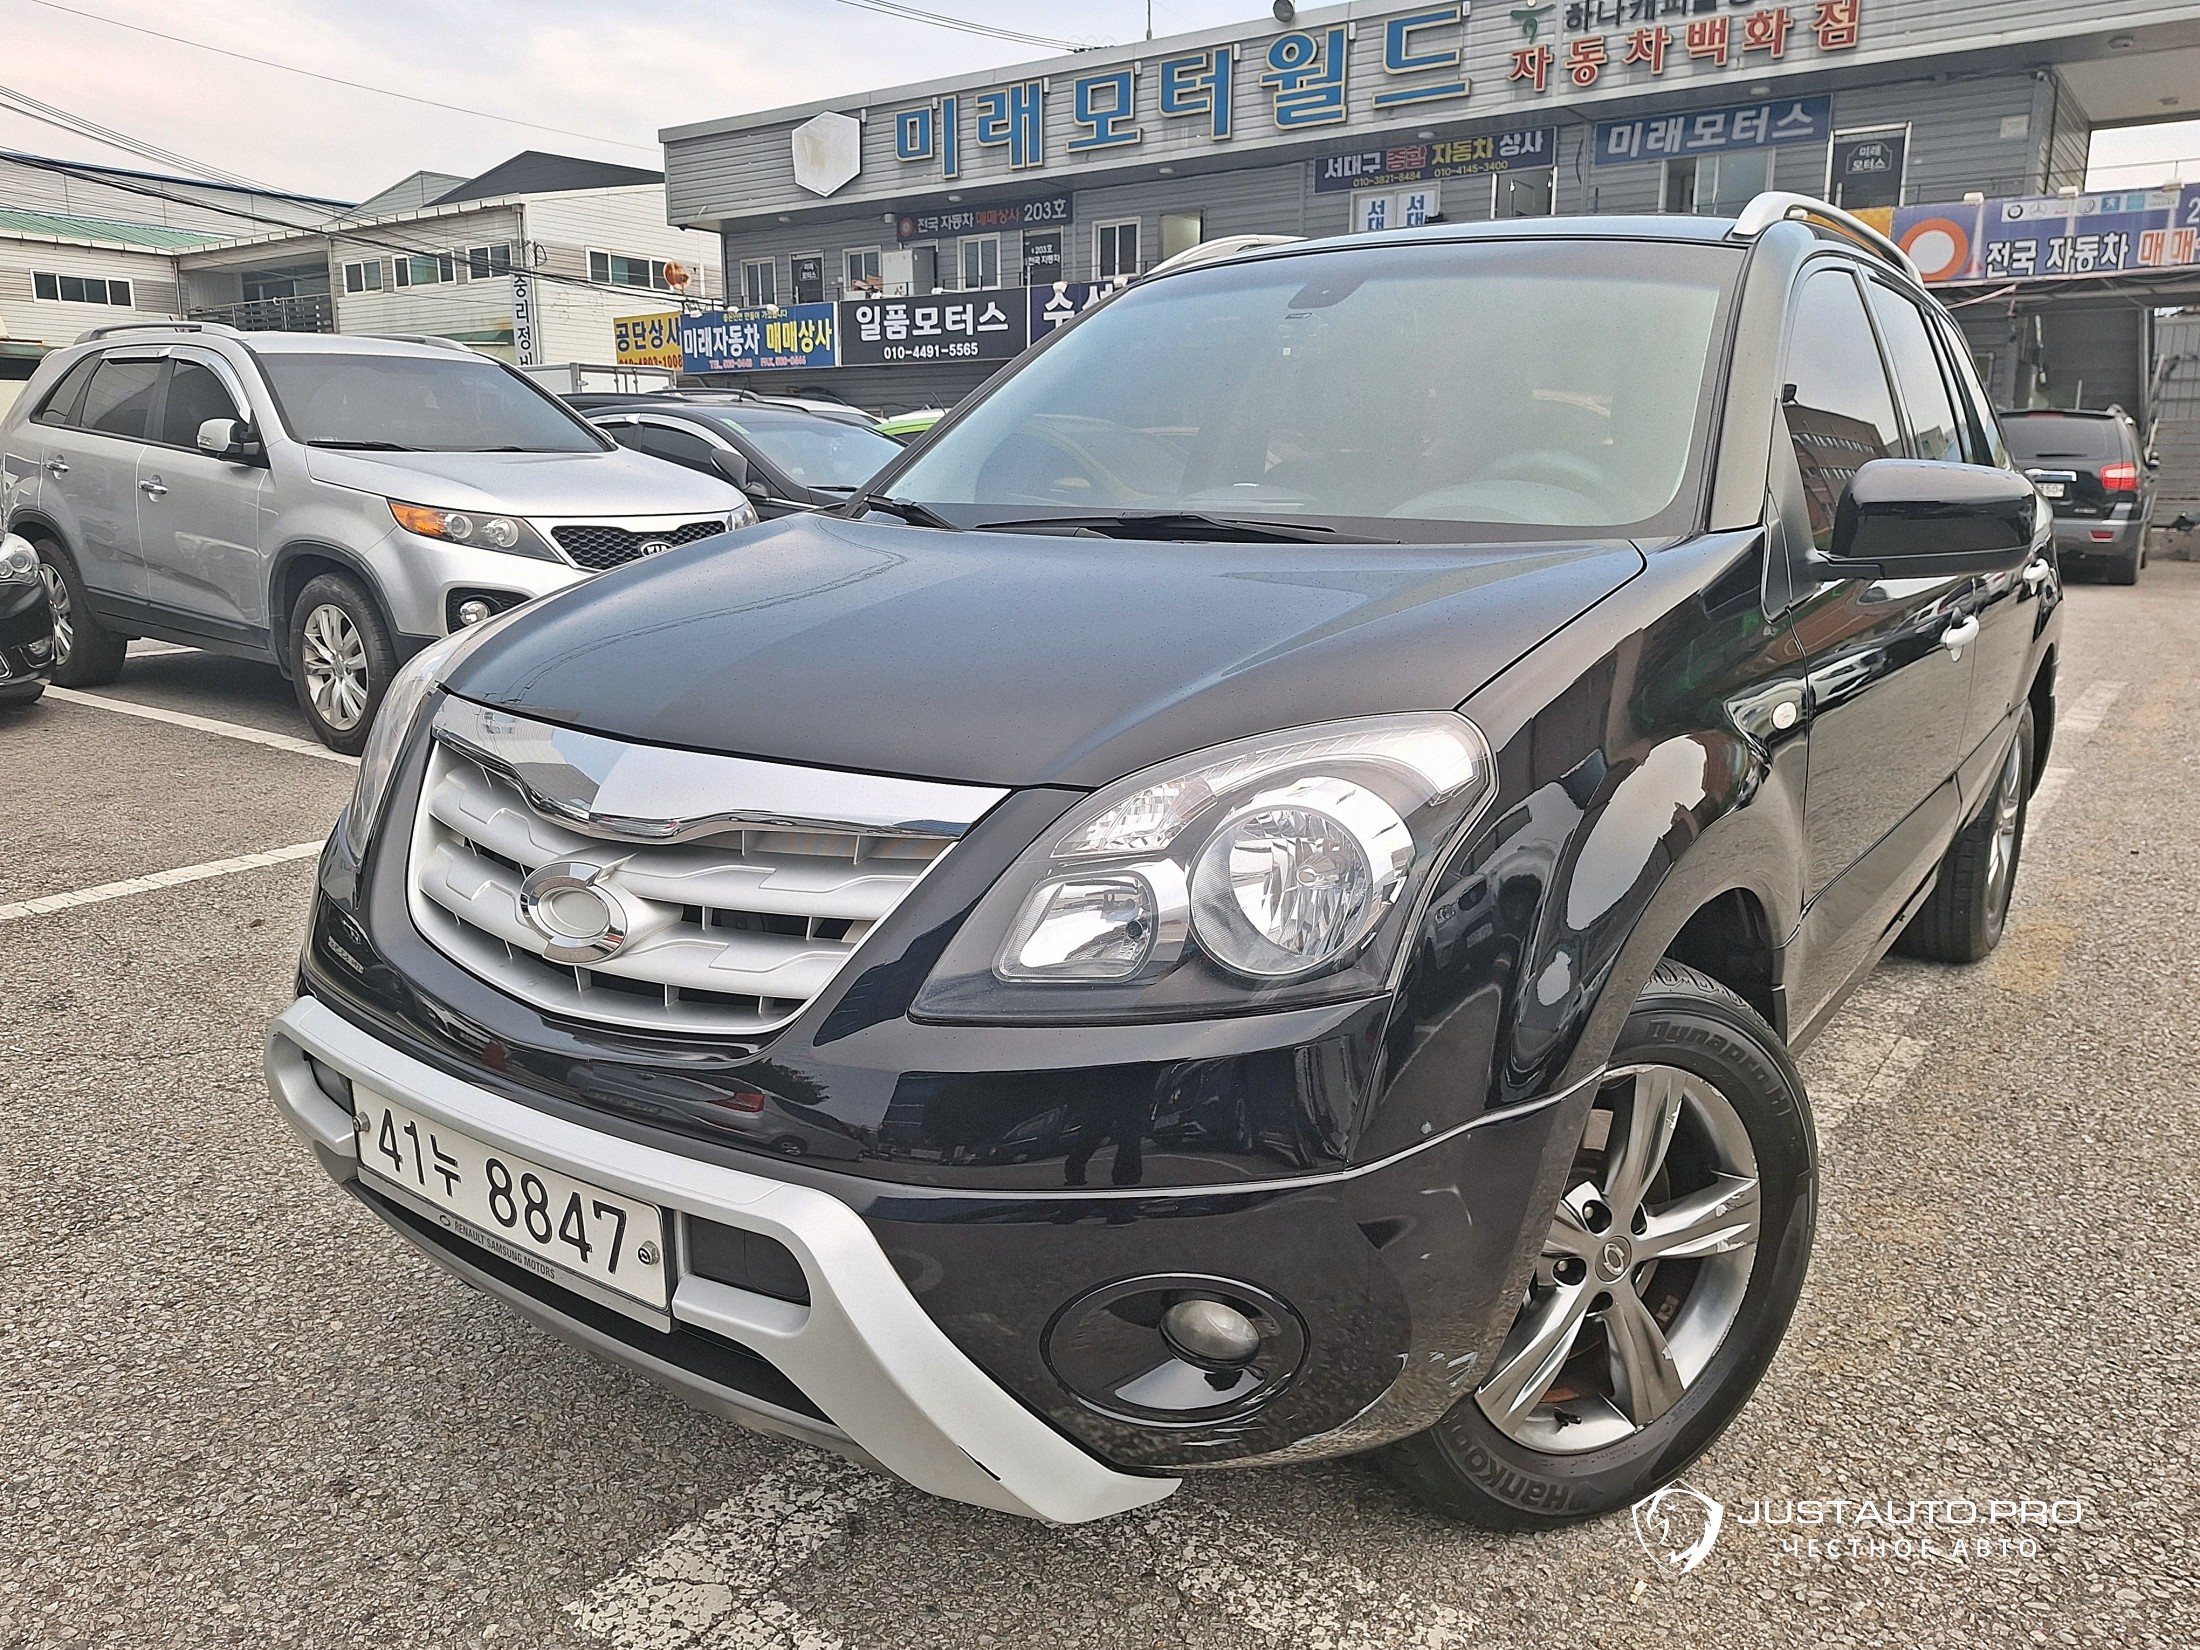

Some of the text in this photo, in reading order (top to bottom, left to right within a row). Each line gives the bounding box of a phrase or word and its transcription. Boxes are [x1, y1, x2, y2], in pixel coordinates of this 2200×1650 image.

[1507, 0, 1862, 92] 자동차백화점
[1607, 102, 1814, 158] 미래모터스
[1324, 130, 1544, 179] 서대구 종합 자동차 상사
[1434, 160, 1509, 178] 010-4145-3400
[917, 199, 1067, 234] 전국 자동차 매매상사 203호
[1986, 226, 2200, 278] 전국 자동차 매매
[616, 315, 681, 353] 공단상사
[683, 318, 833, 358] 미래자동차 매매상사
[855, 301, 1009, 342] 일품모터스
[883, 342, 979, 360] 010-4491-5565
[379, 1108, 627, 1274] 41누 8847
[454, 1221, 555, 1279] RENAULT SAMSUNG MOTORS
